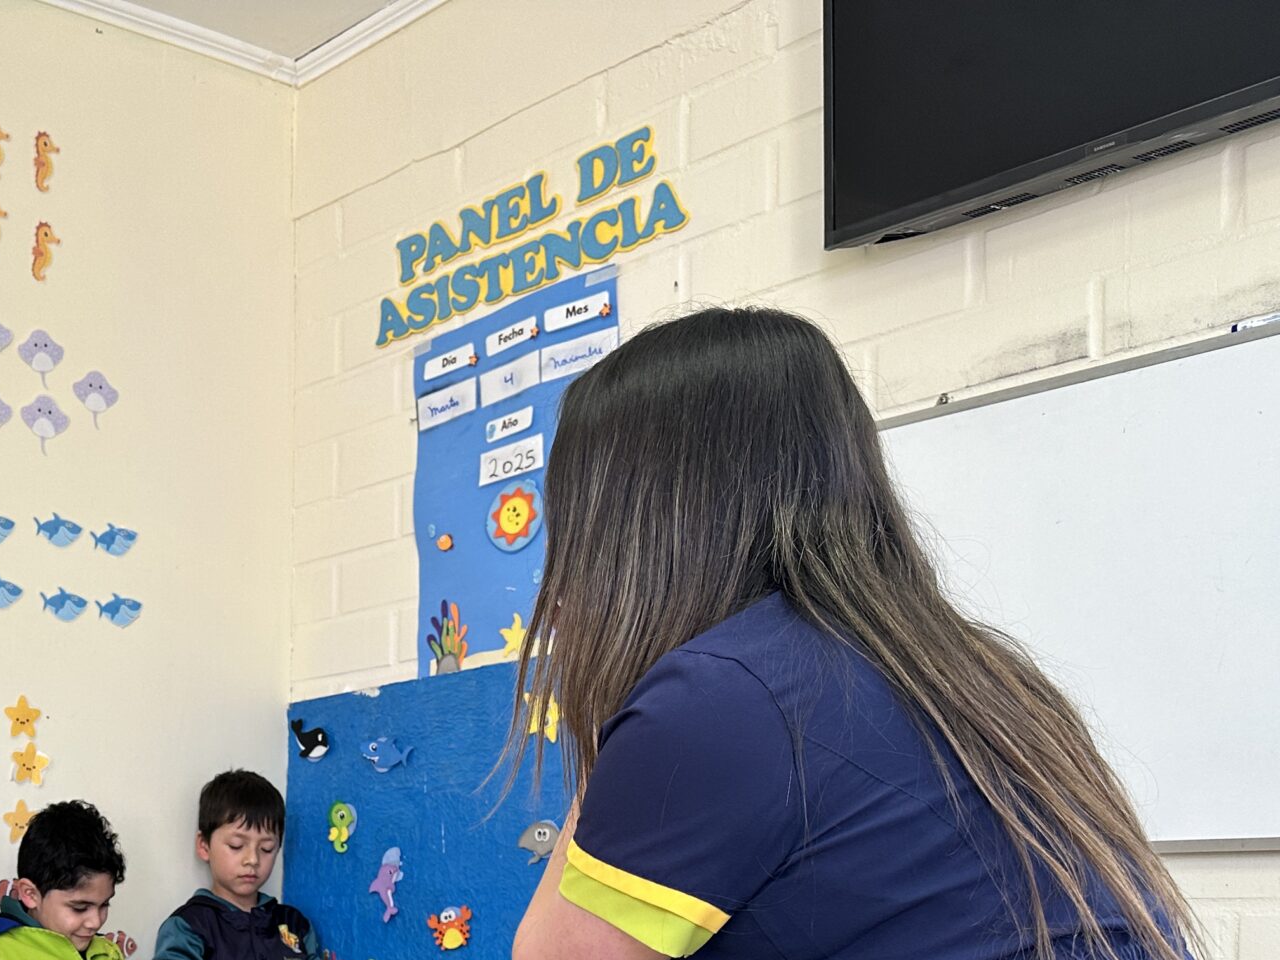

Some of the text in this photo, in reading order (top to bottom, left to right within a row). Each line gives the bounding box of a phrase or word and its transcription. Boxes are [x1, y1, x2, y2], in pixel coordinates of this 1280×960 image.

[396, 126, 656, 283] PANEL DE
[375, 179, 687, 346] ASISTENCIA
[565, 304, 589, 320] Mes
[497, 326, 525, 346] Fecha
[441, 355, 458, 369] Día
[503, 372, 514, 385] 4
[500, 416, 519, 432] Año
[488, 449, 537, 478] 2025
